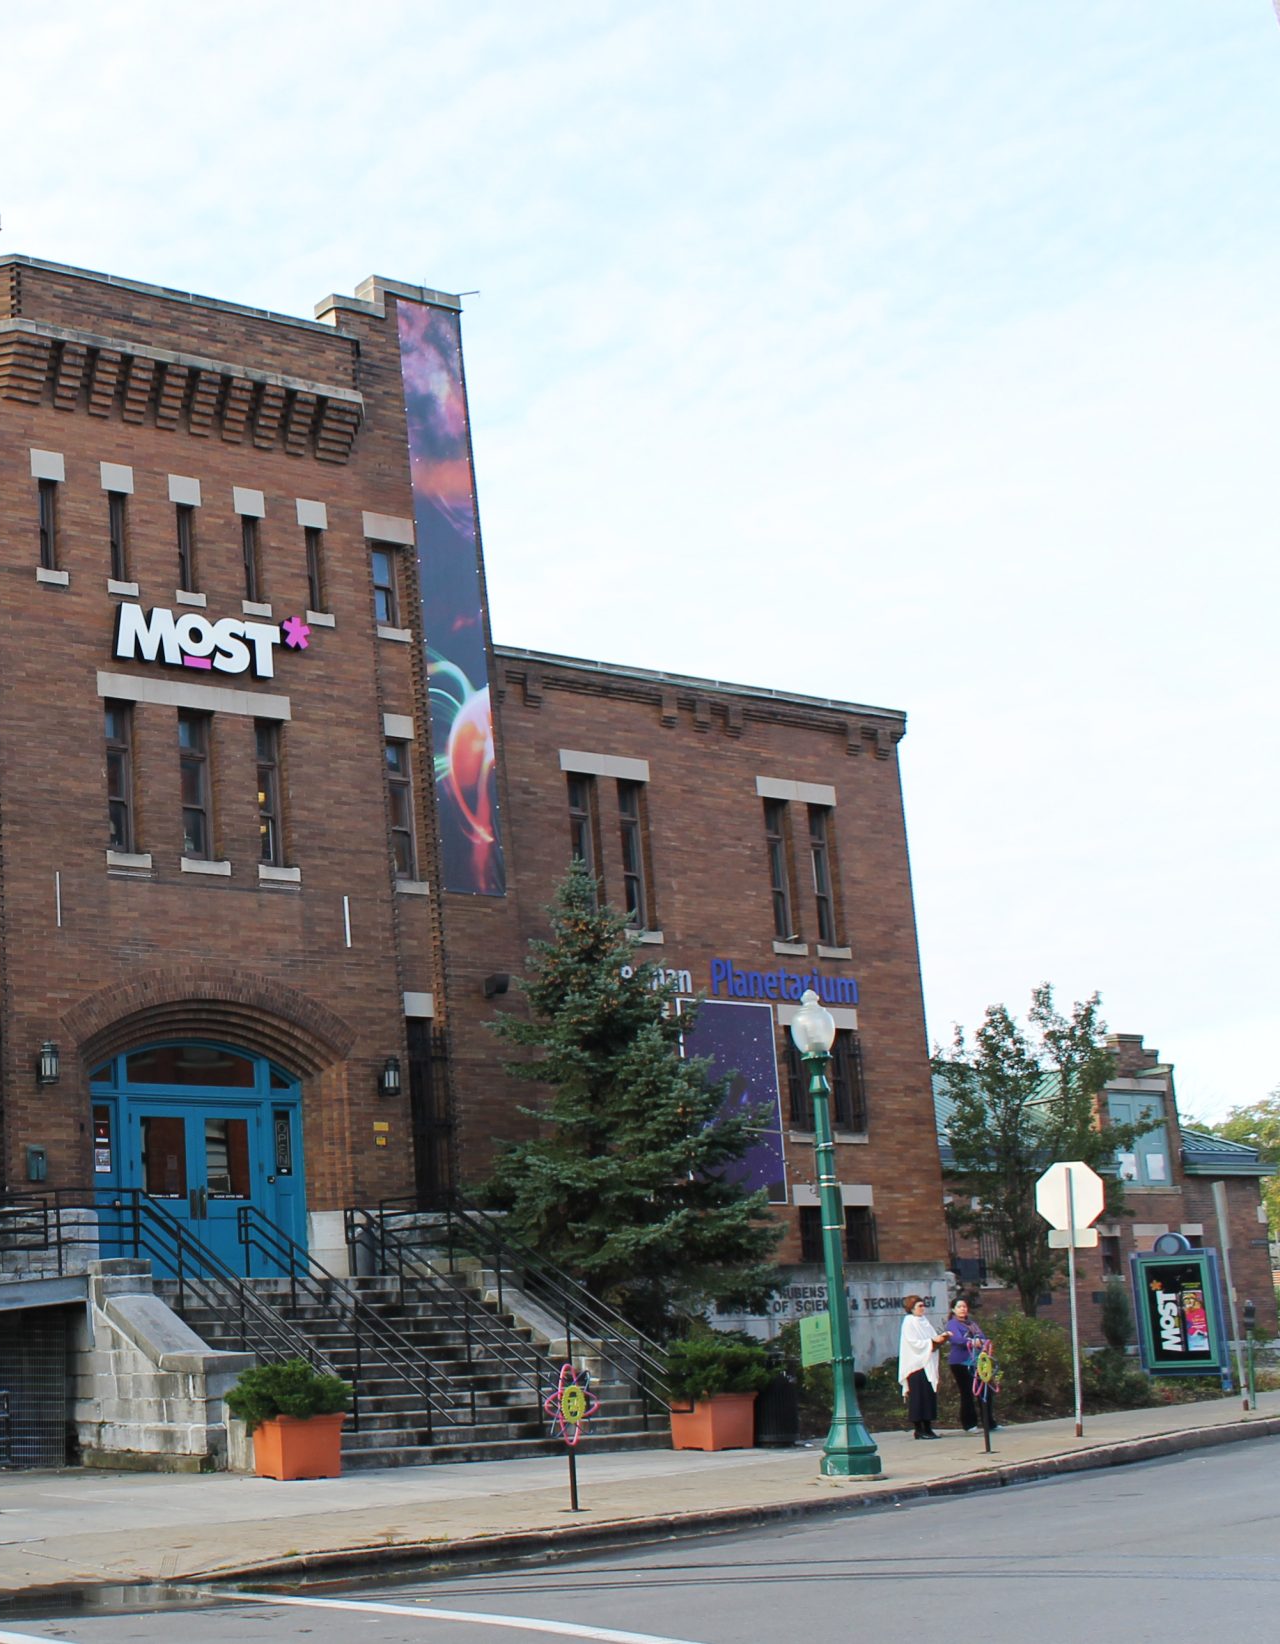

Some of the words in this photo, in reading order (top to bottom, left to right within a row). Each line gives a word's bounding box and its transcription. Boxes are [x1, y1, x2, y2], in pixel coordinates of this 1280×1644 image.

[116, 601, 281, 678] MOST
[710, 959, 859, 1005] Planetarium
[773, 1300, 789, 1313] OF
[795, 1299, 829, 1312] SCIEN
[863, 1296, 936, 1310] TECHNGY
[1155, 1290, 1183, 1351] MOST
